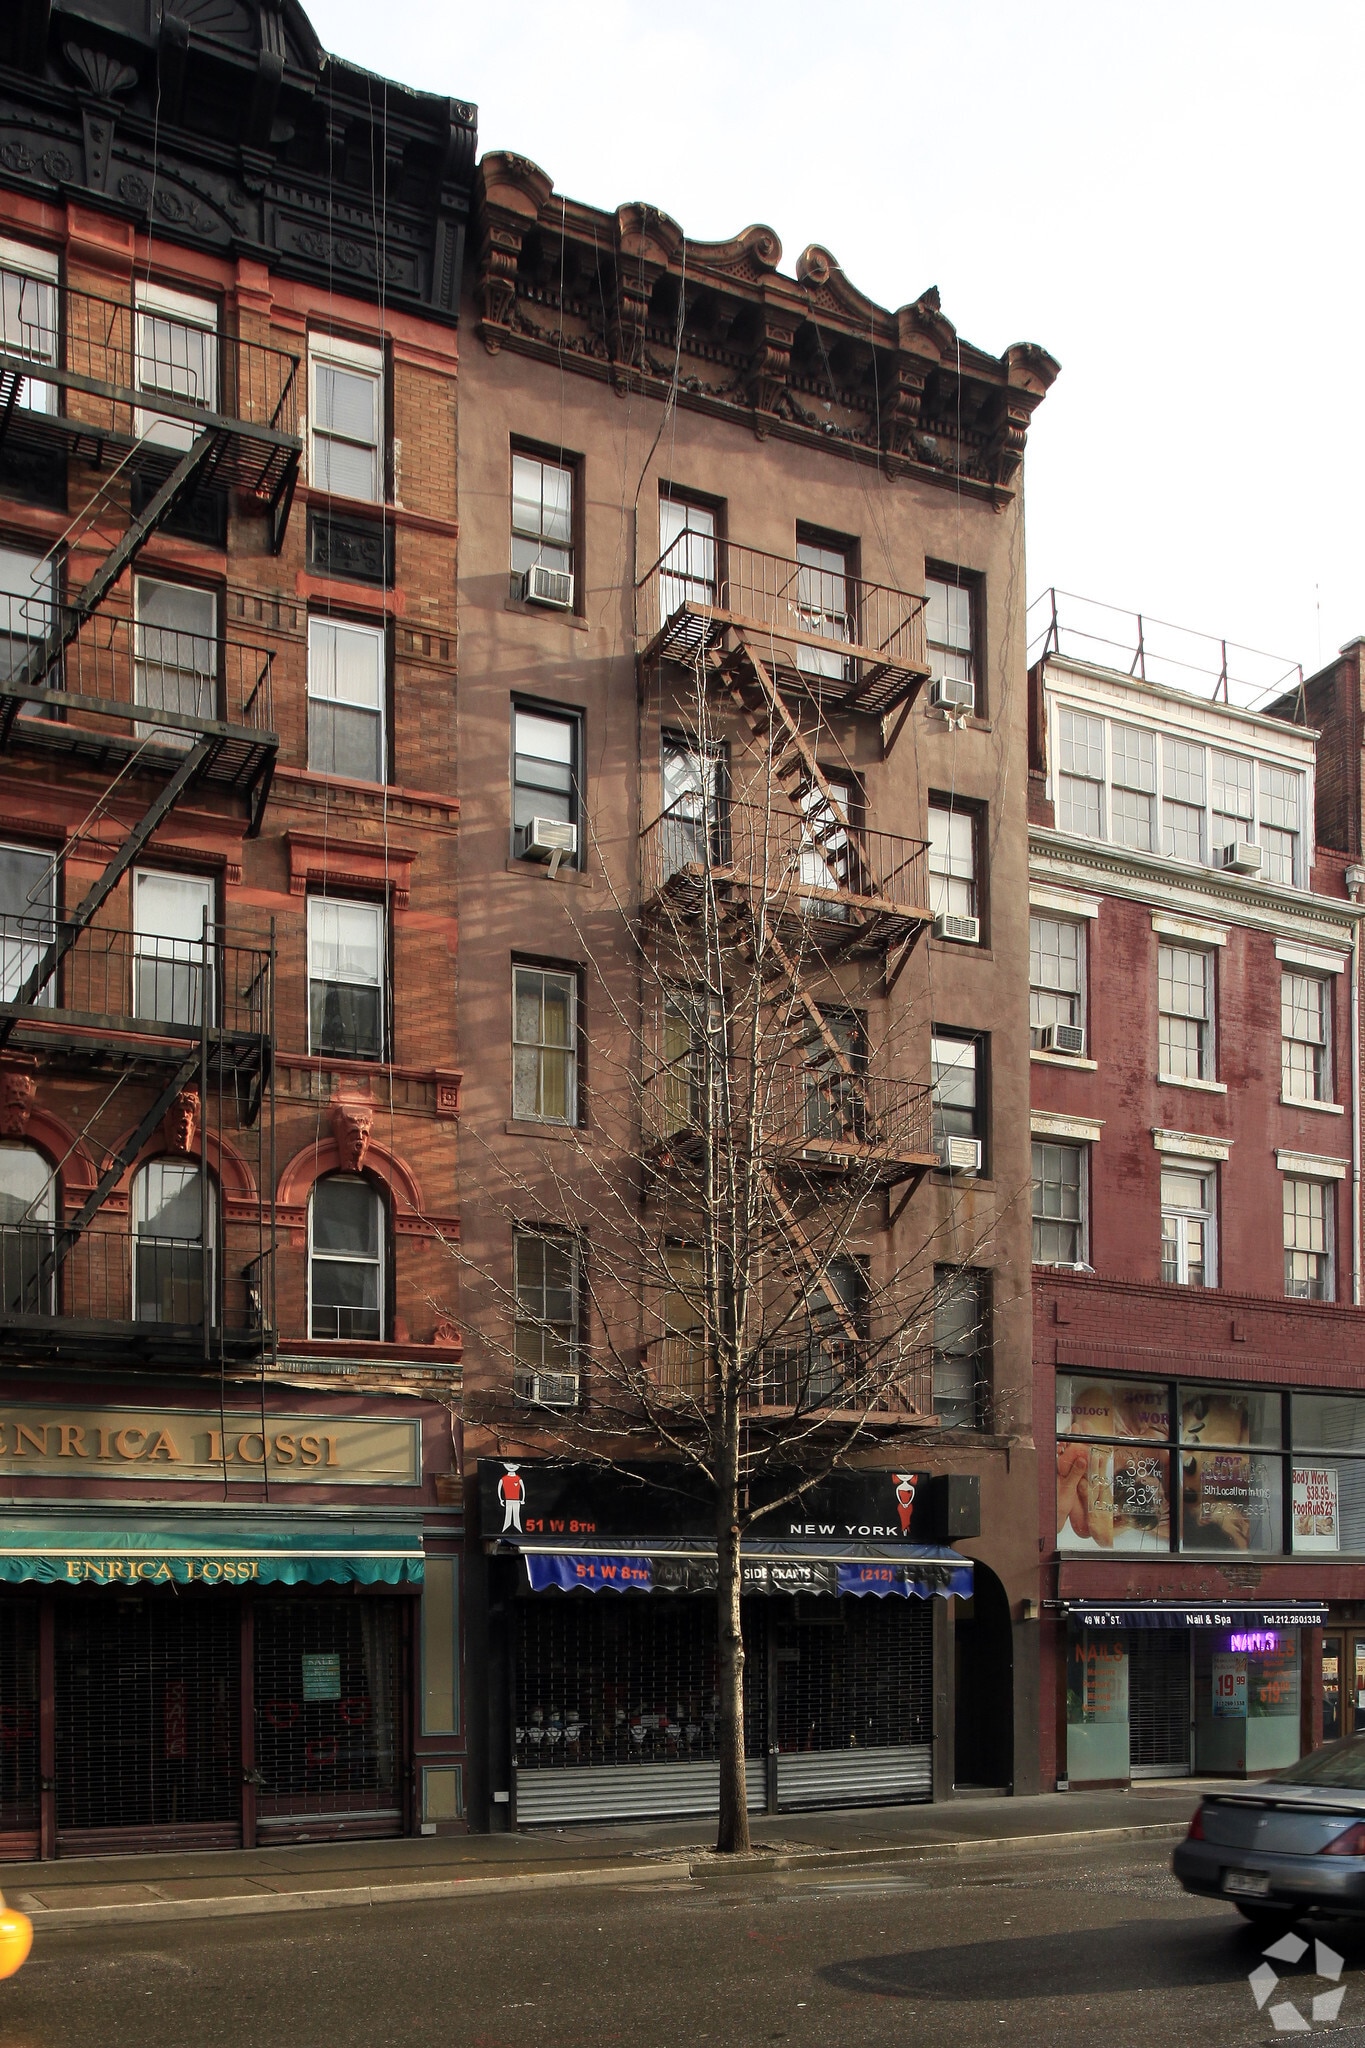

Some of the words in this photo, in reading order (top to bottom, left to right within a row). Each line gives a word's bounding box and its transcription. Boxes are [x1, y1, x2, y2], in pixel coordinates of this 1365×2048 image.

[207, 1430, 340, 1466] LOSSI
[1292, 1469, 1309, 1485] Body
[1311, 1470, 1328, 1485] Work
[525, 1519, 544, 1532] 51
[550, 1519, 565, 1532] W
[569, 1520, 596, 1533] 8TH
[790, 1524, 836, 1535] NEW
[845, 1525, 898, 1536] YORK
[65, 1561, 174, 1579] ENRICA
[185, 1561, 261, 1579] LOSSI
[576, 1565, 595, 1578] 51
[601, 1566, 617, 1579] W
[621, 1567, 648, 1580] 8TH
[744, 1568, 768, 1579] SIDE
[860, 1569, 893, 1582] (212)
[1084, 1616, 1092, 1625] 49
[1093, 1616, 1100, 1625] W
[1186, 1614, 1204, 1625] Nail
[1205, 1614, 1212, 1625] &
[1214, 1614, 1232, 1626] Spa
[1075, 1642, 1124, 1663] NAILS
